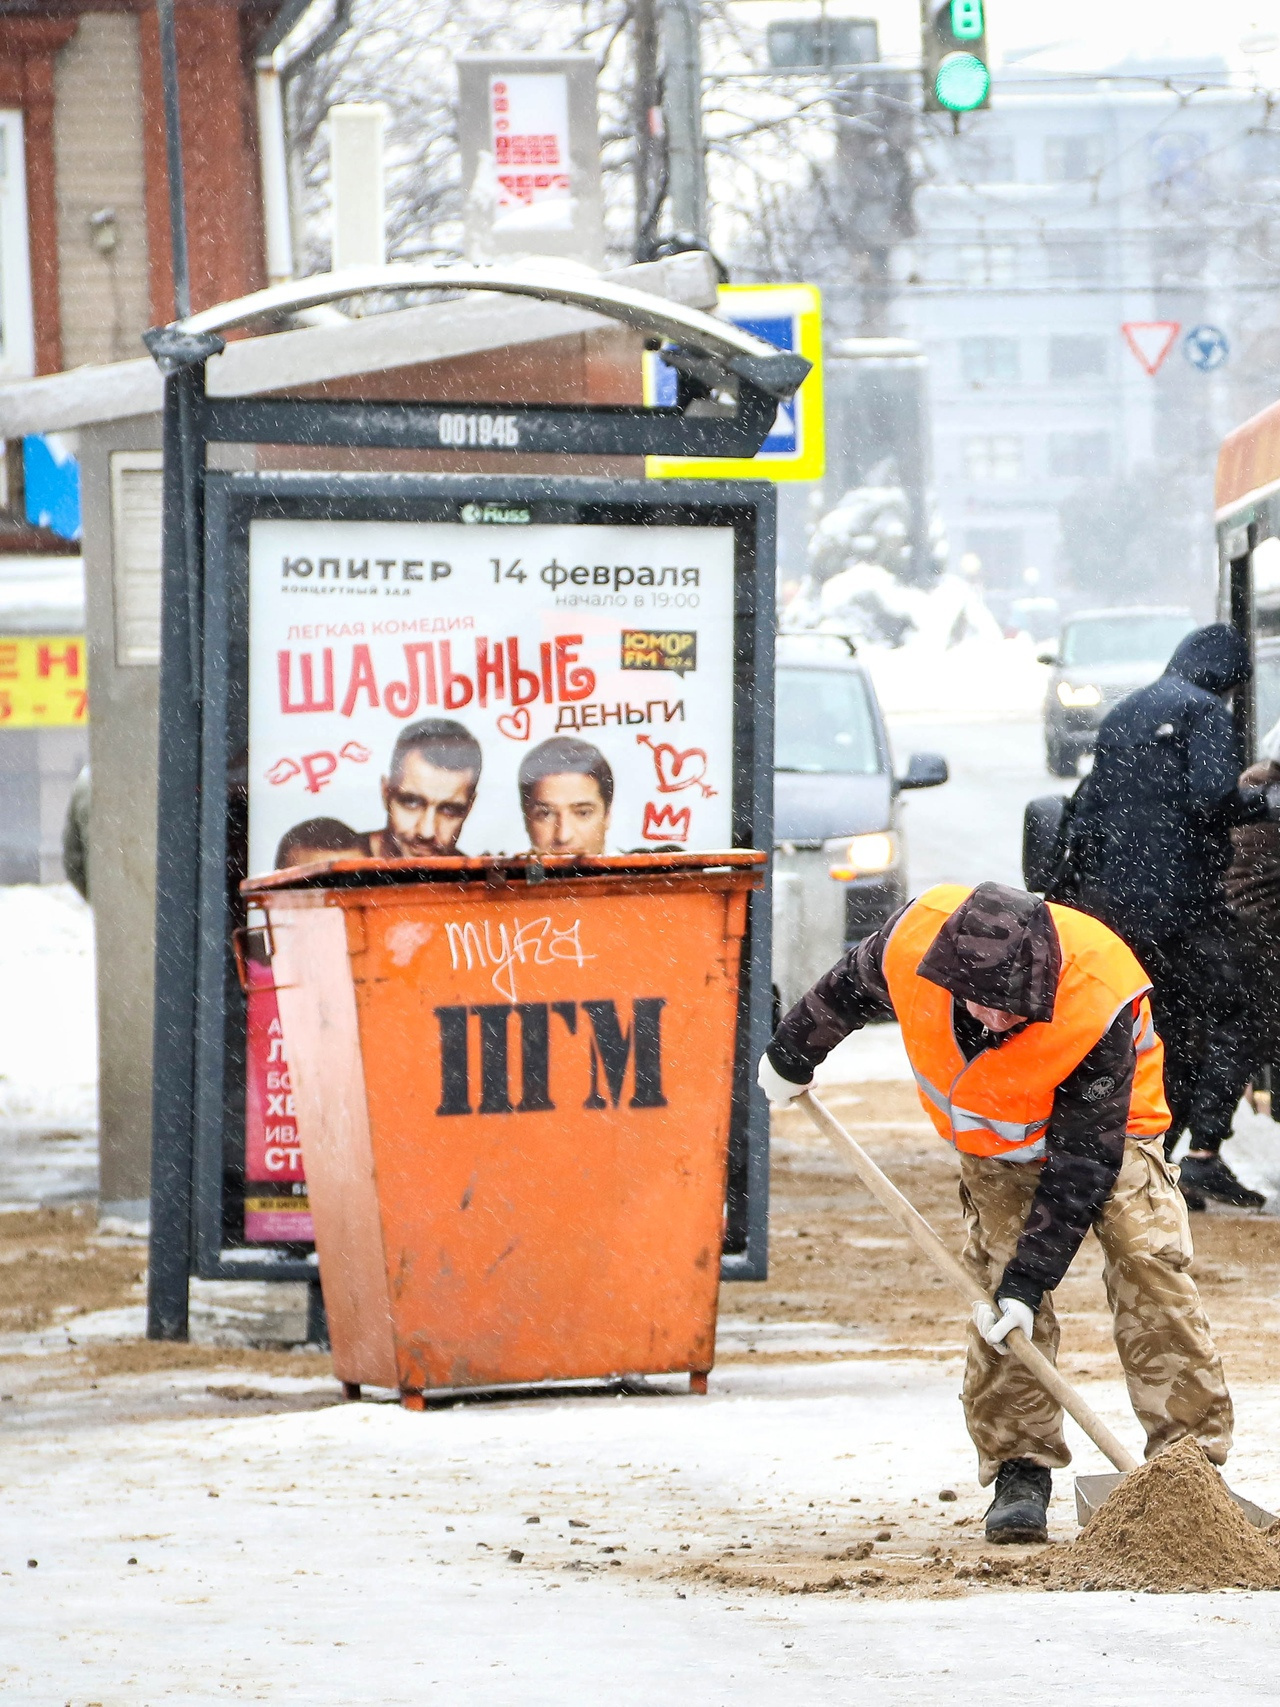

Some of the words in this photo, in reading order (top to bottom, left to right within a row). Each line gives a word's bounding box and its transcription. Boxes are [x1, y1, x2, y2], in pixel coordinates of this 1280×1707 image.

[282, 556, 452, 582] ЮПИТЕР
[489, 558, 528, 584] 14
[540, 558, 700, 592] февраля
[555, 595, 627, 608] начало
[634, 596, 645, 608] в
[651, 592, 700, 609] 19:00
[287, 621, 366, 640] ЛЕГКАЯ
[372, 615, 476, 635] КОМЕДИЯ
[624, 632, 694, 656] ЮМОР
[624, 650, 658, 667] FM
[277, 633, 596, 719] ШАЛЬНЫЕ
[554, 700, 686, 733] ДЕНЬГИ
[433, 997, 669, 1117] ПГМ
